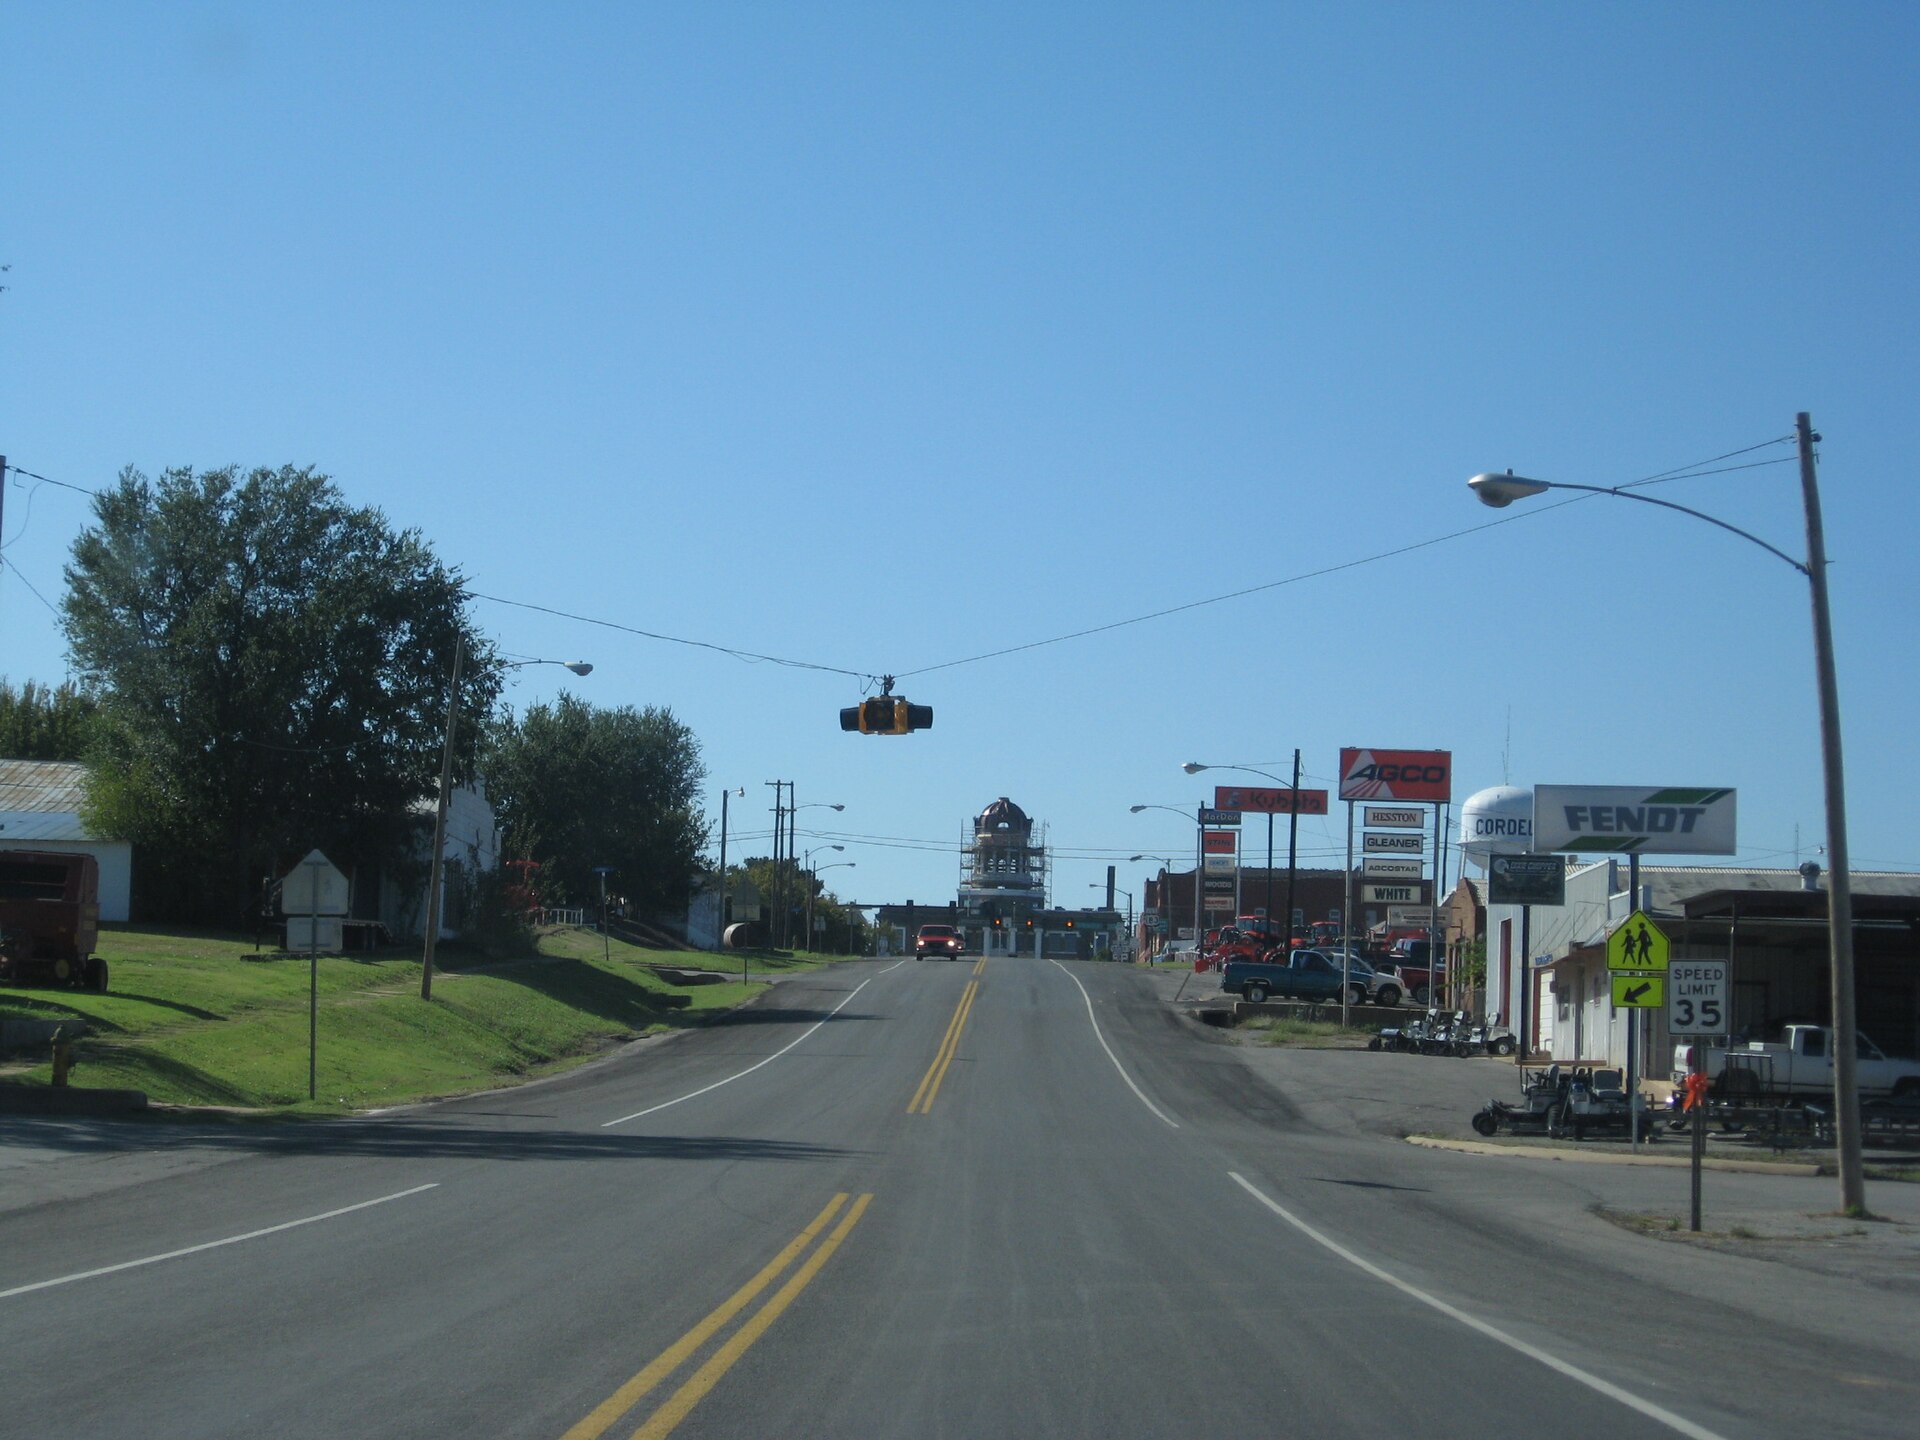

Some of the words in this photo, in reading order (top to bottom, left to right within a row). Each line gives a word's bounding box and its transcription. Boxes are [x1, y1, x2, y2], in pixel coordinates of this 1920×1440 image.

[1346, 764, 1446, 783] AGCO
[1372, 812, 1417, 823] HESSTON
[1564, 805, 1706, 833] FENDT
[1367, 837, 1419, 848] GLEANER
[1368, 865, 1418, 873] AGCOSTAR
[1205, 881, 1233, 889] WOODS
[1374, 887, 1411, 900] WHITE
[1674, 968, 1723, 980] SPEED
[1678, 984, 1717, 995] LIMIT
[1673, 999, 1721, 1027] 35
